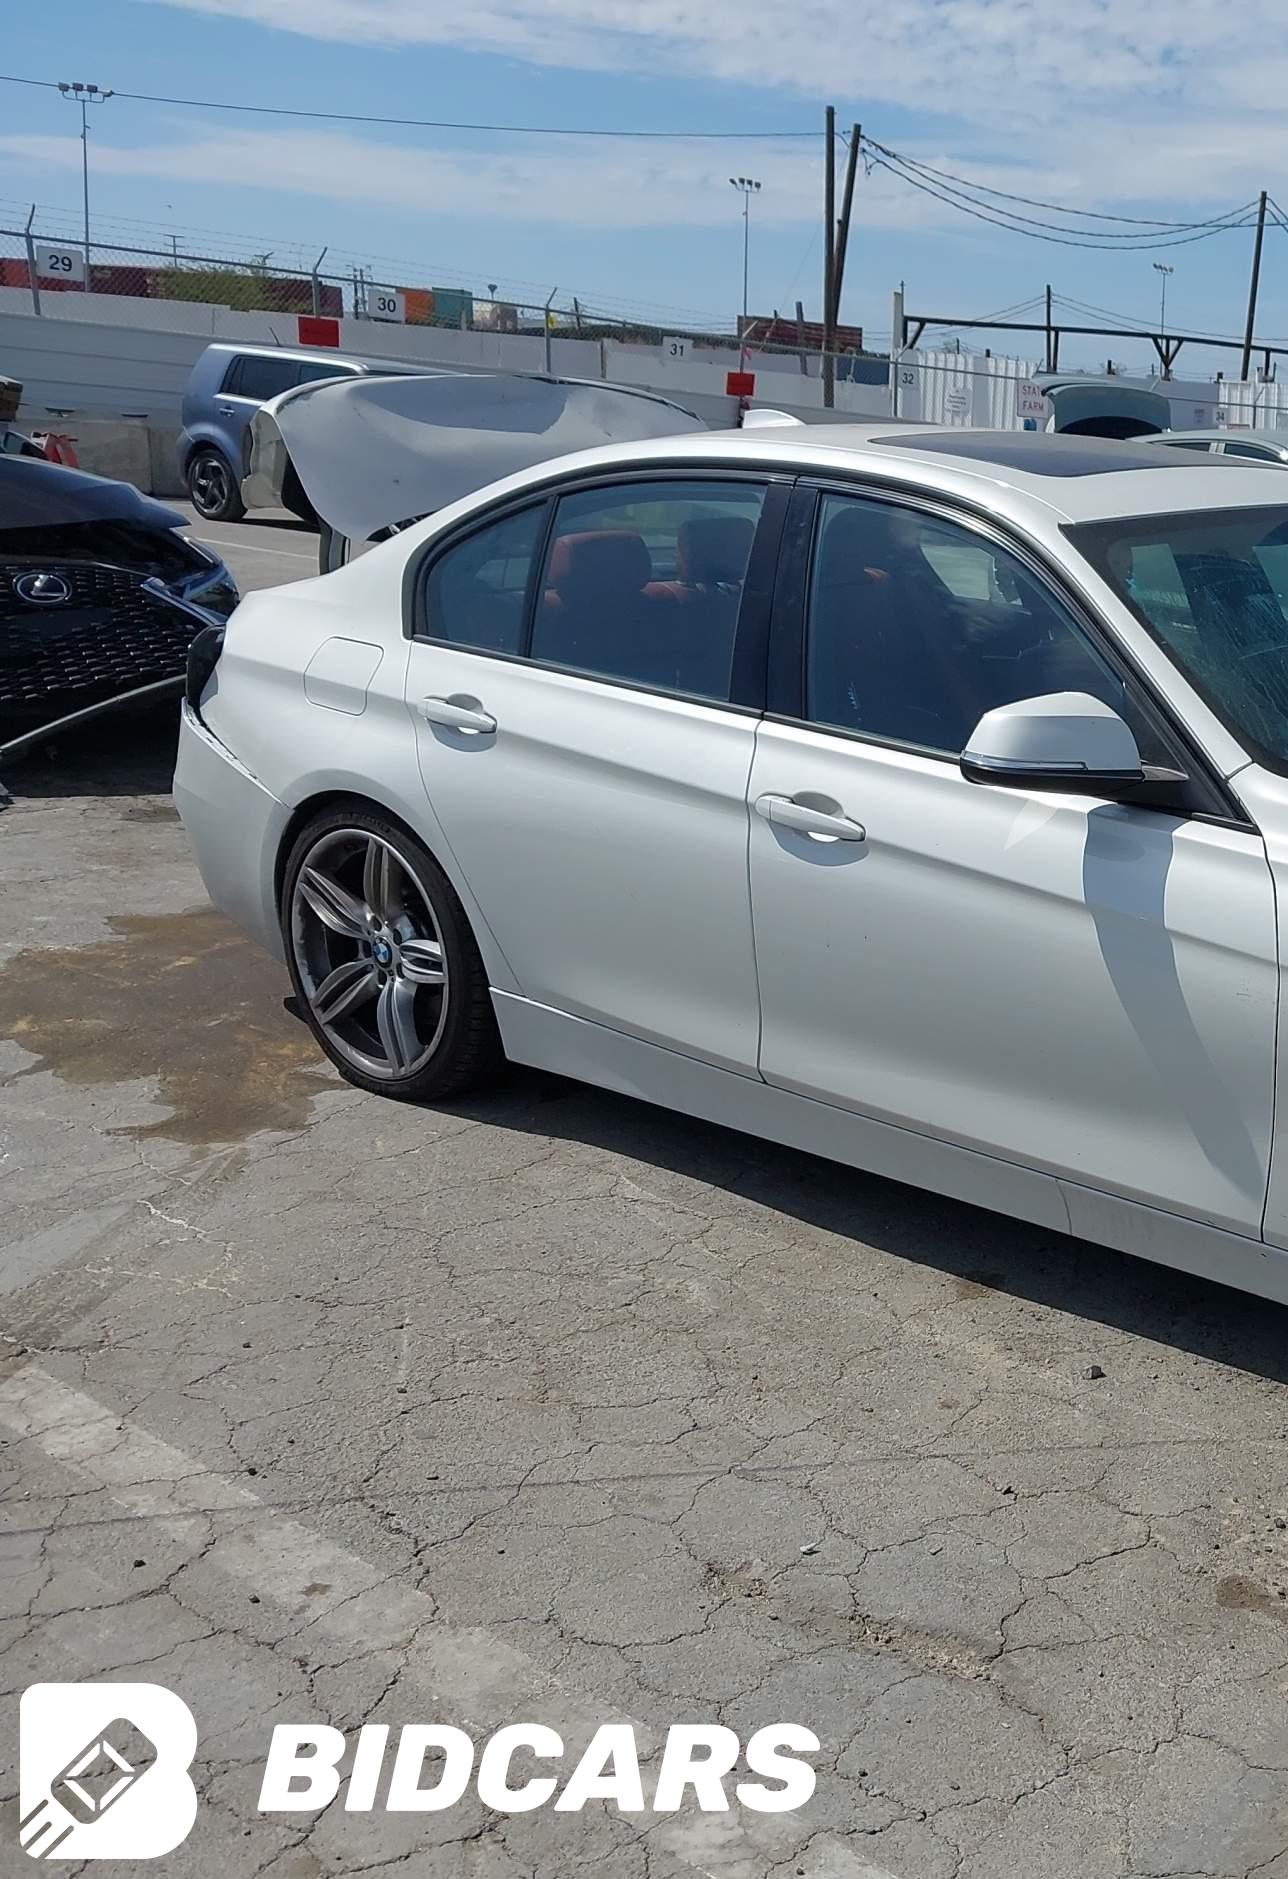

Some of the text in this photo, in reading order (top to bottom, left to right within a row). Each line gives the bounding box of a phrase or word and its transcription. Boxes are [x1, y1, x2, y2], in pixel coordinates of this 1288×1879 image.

[48, 254, 73, 272] 29
[377, 297, 397, 313] 30
[670, 343, 685, 357] 31
[902, 372, 914, 385] 32
[1022, 384, 1041, 397] STAT
